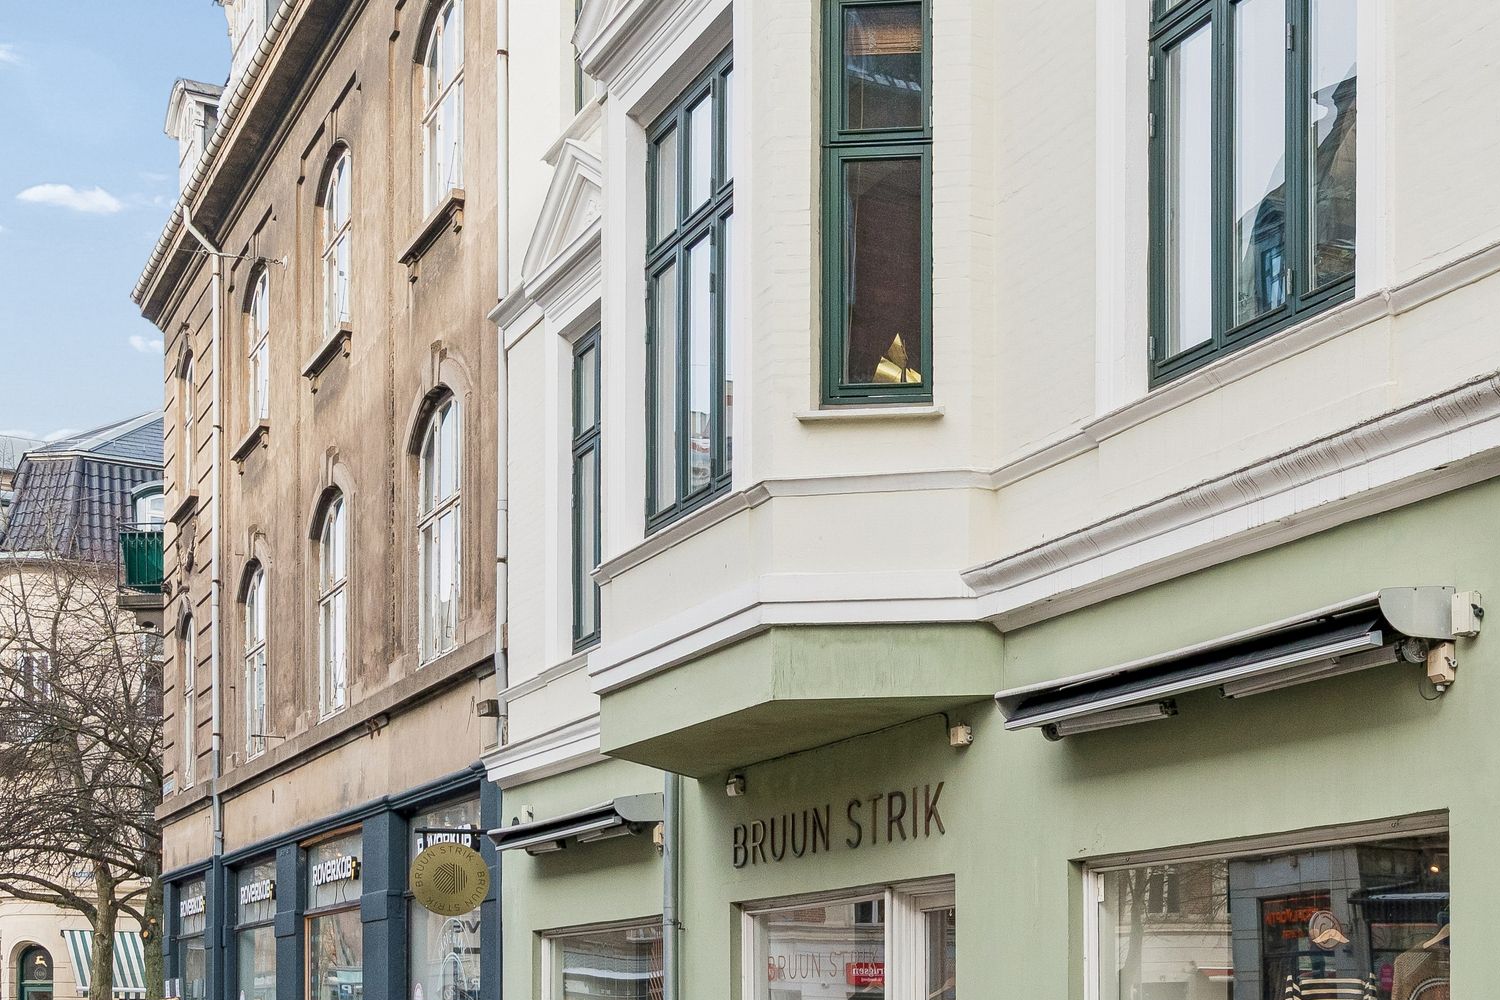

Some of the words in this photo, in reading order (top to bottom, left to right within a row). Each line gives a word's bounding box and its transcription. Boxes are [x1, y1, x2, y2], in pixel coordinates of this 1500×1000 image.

[732, 803, 831, 869] BRUUN
[845, 781, 946, 849] STRIK
[414, 850, 436, 888] BRUUN
[439, 845, 475, 862] STRIK
[426, 896, 460, 912] STRIK
[464, 870, 486, 908] BRUUN
